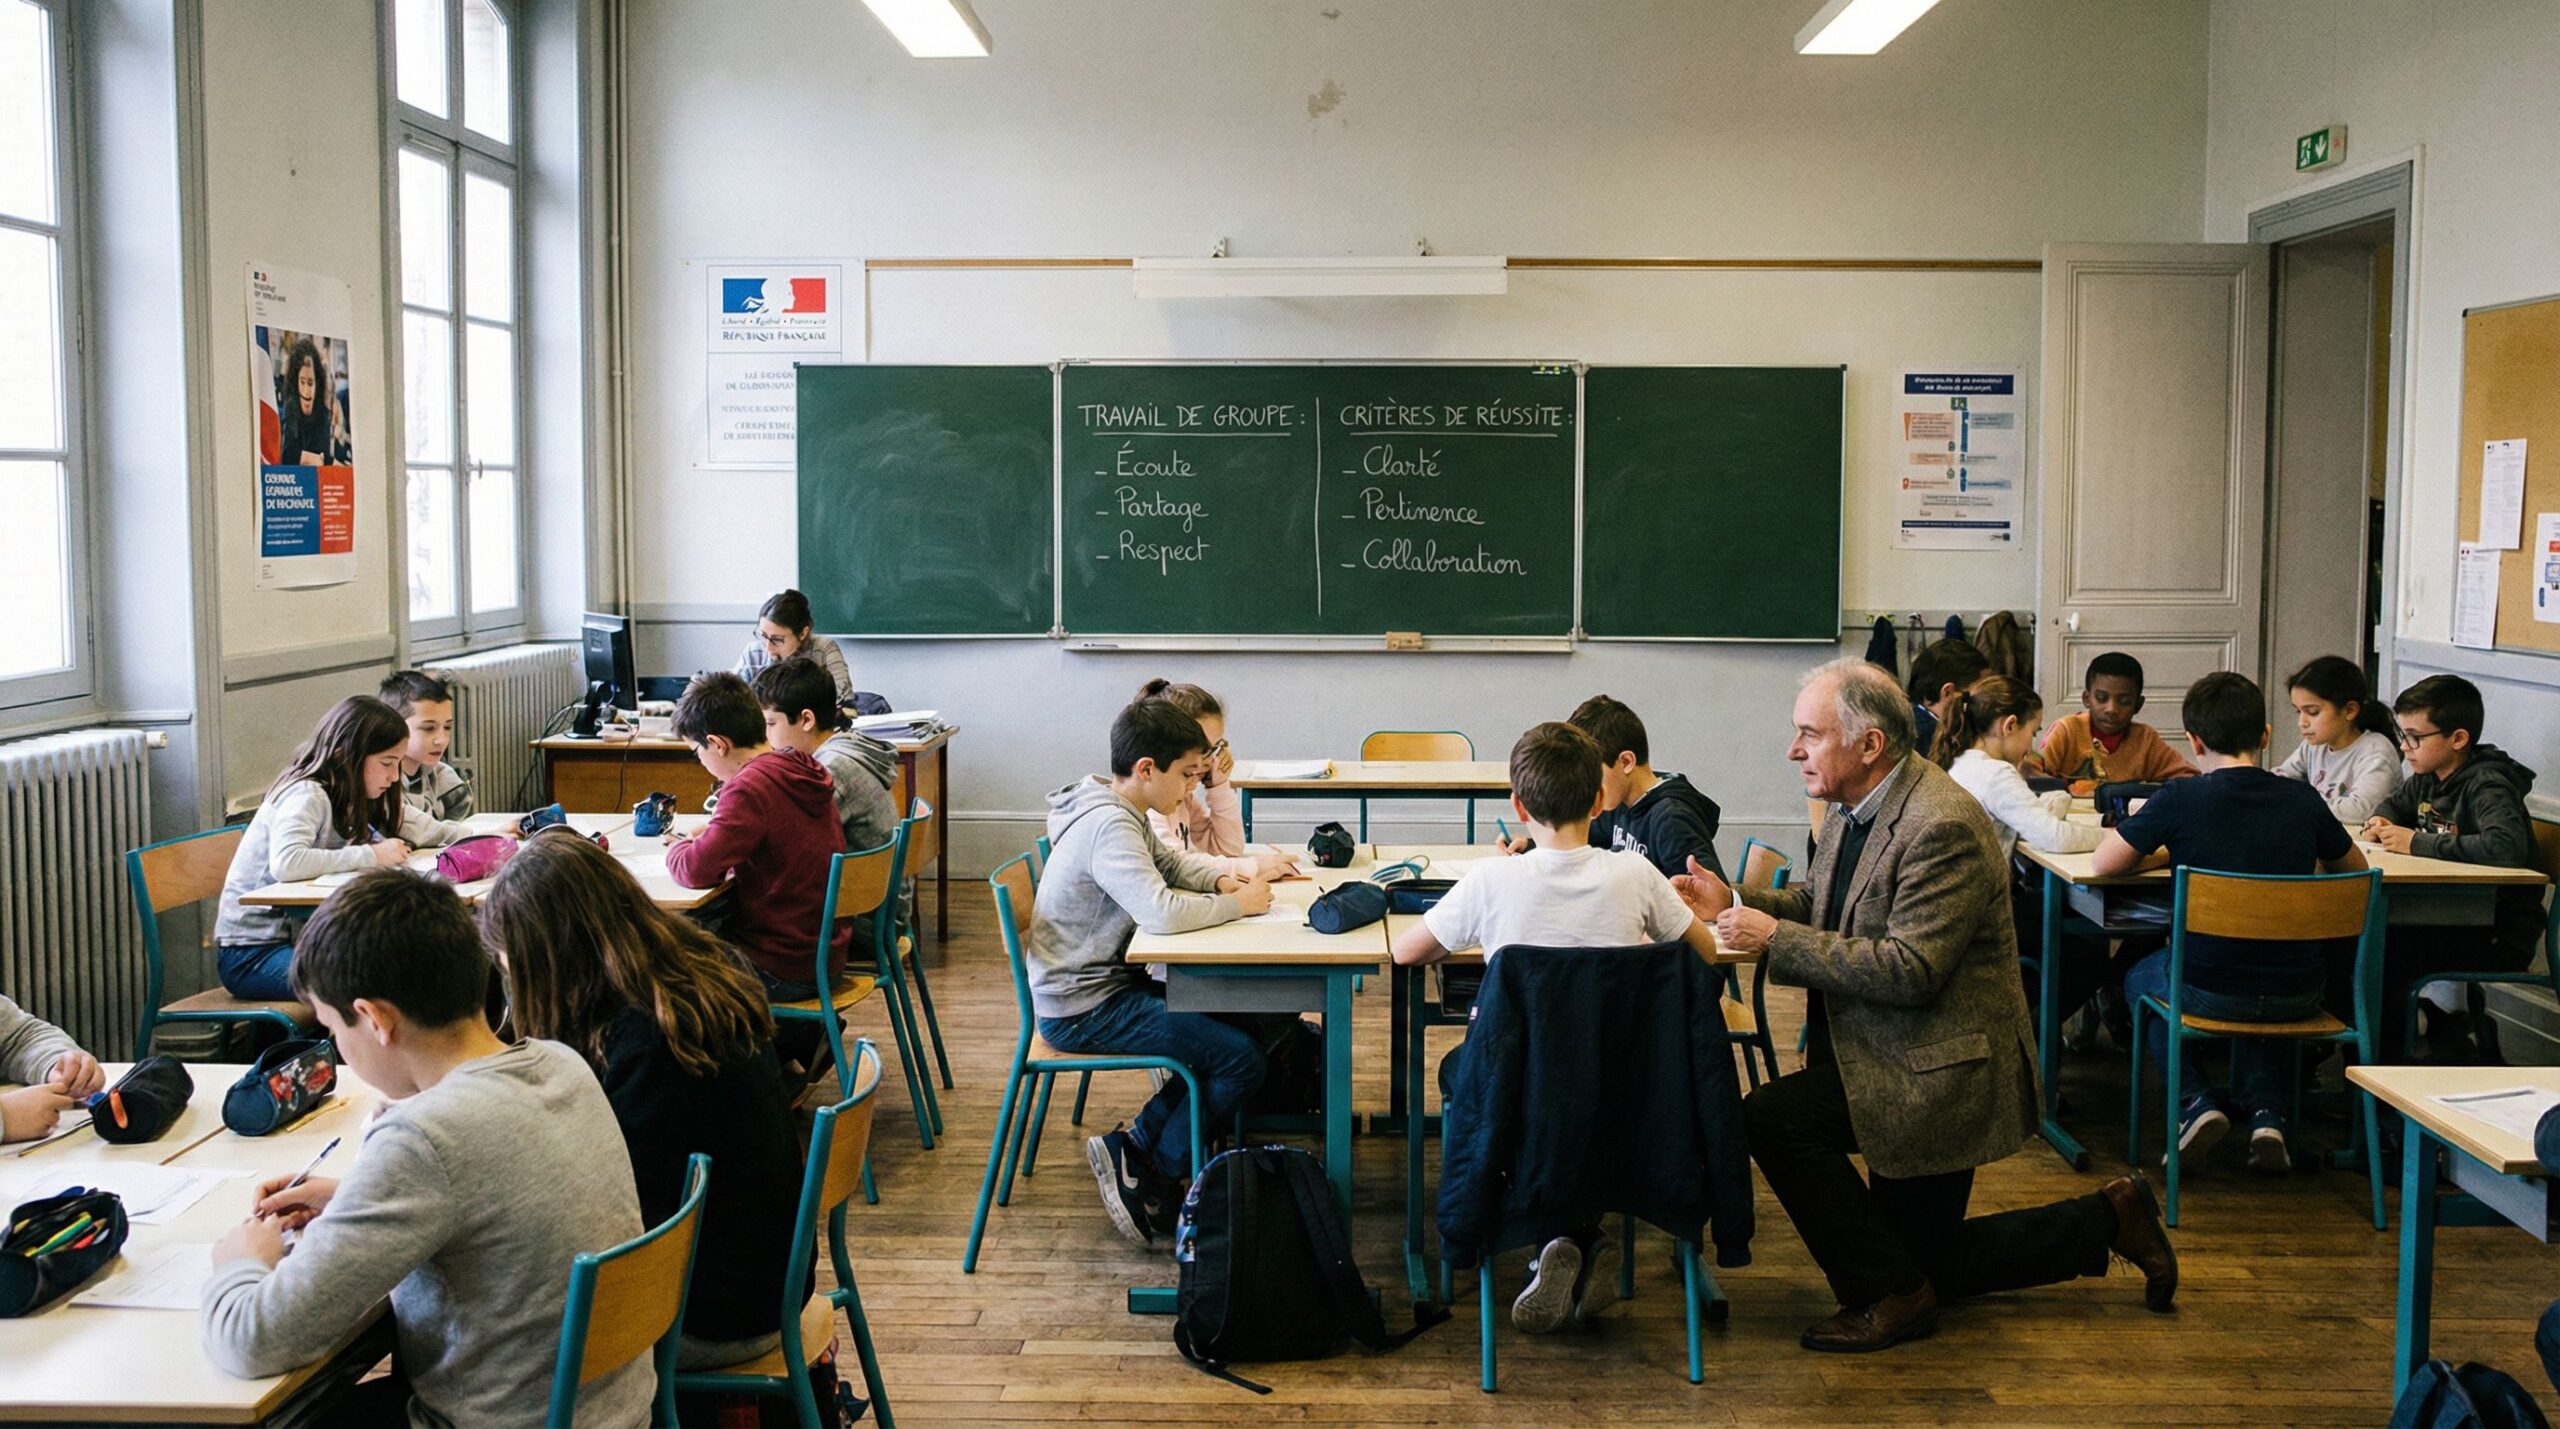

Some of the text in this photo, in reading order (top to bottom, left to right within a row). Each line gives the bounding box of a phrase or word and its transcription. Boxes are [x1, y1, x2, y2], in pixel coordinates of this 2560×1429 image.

[1077, 402, 1168, 427] TRAVAIL
[1176, 404, 1206, 428] DE
[1339, 396, 1436, 426] CRITÈRES
[1444, 406, 1469, 427] DE
[1116, 439, 1198, 477] Écoute
[1363, 443, 1442, 477] Clarté
[1114, 485, 1210, 534] Partage
[1359, 486, 1486, 525] Pertinence
[1119, 529, 1211, 576] Respect
[1363, 537, 1528, 576] Collaboration
